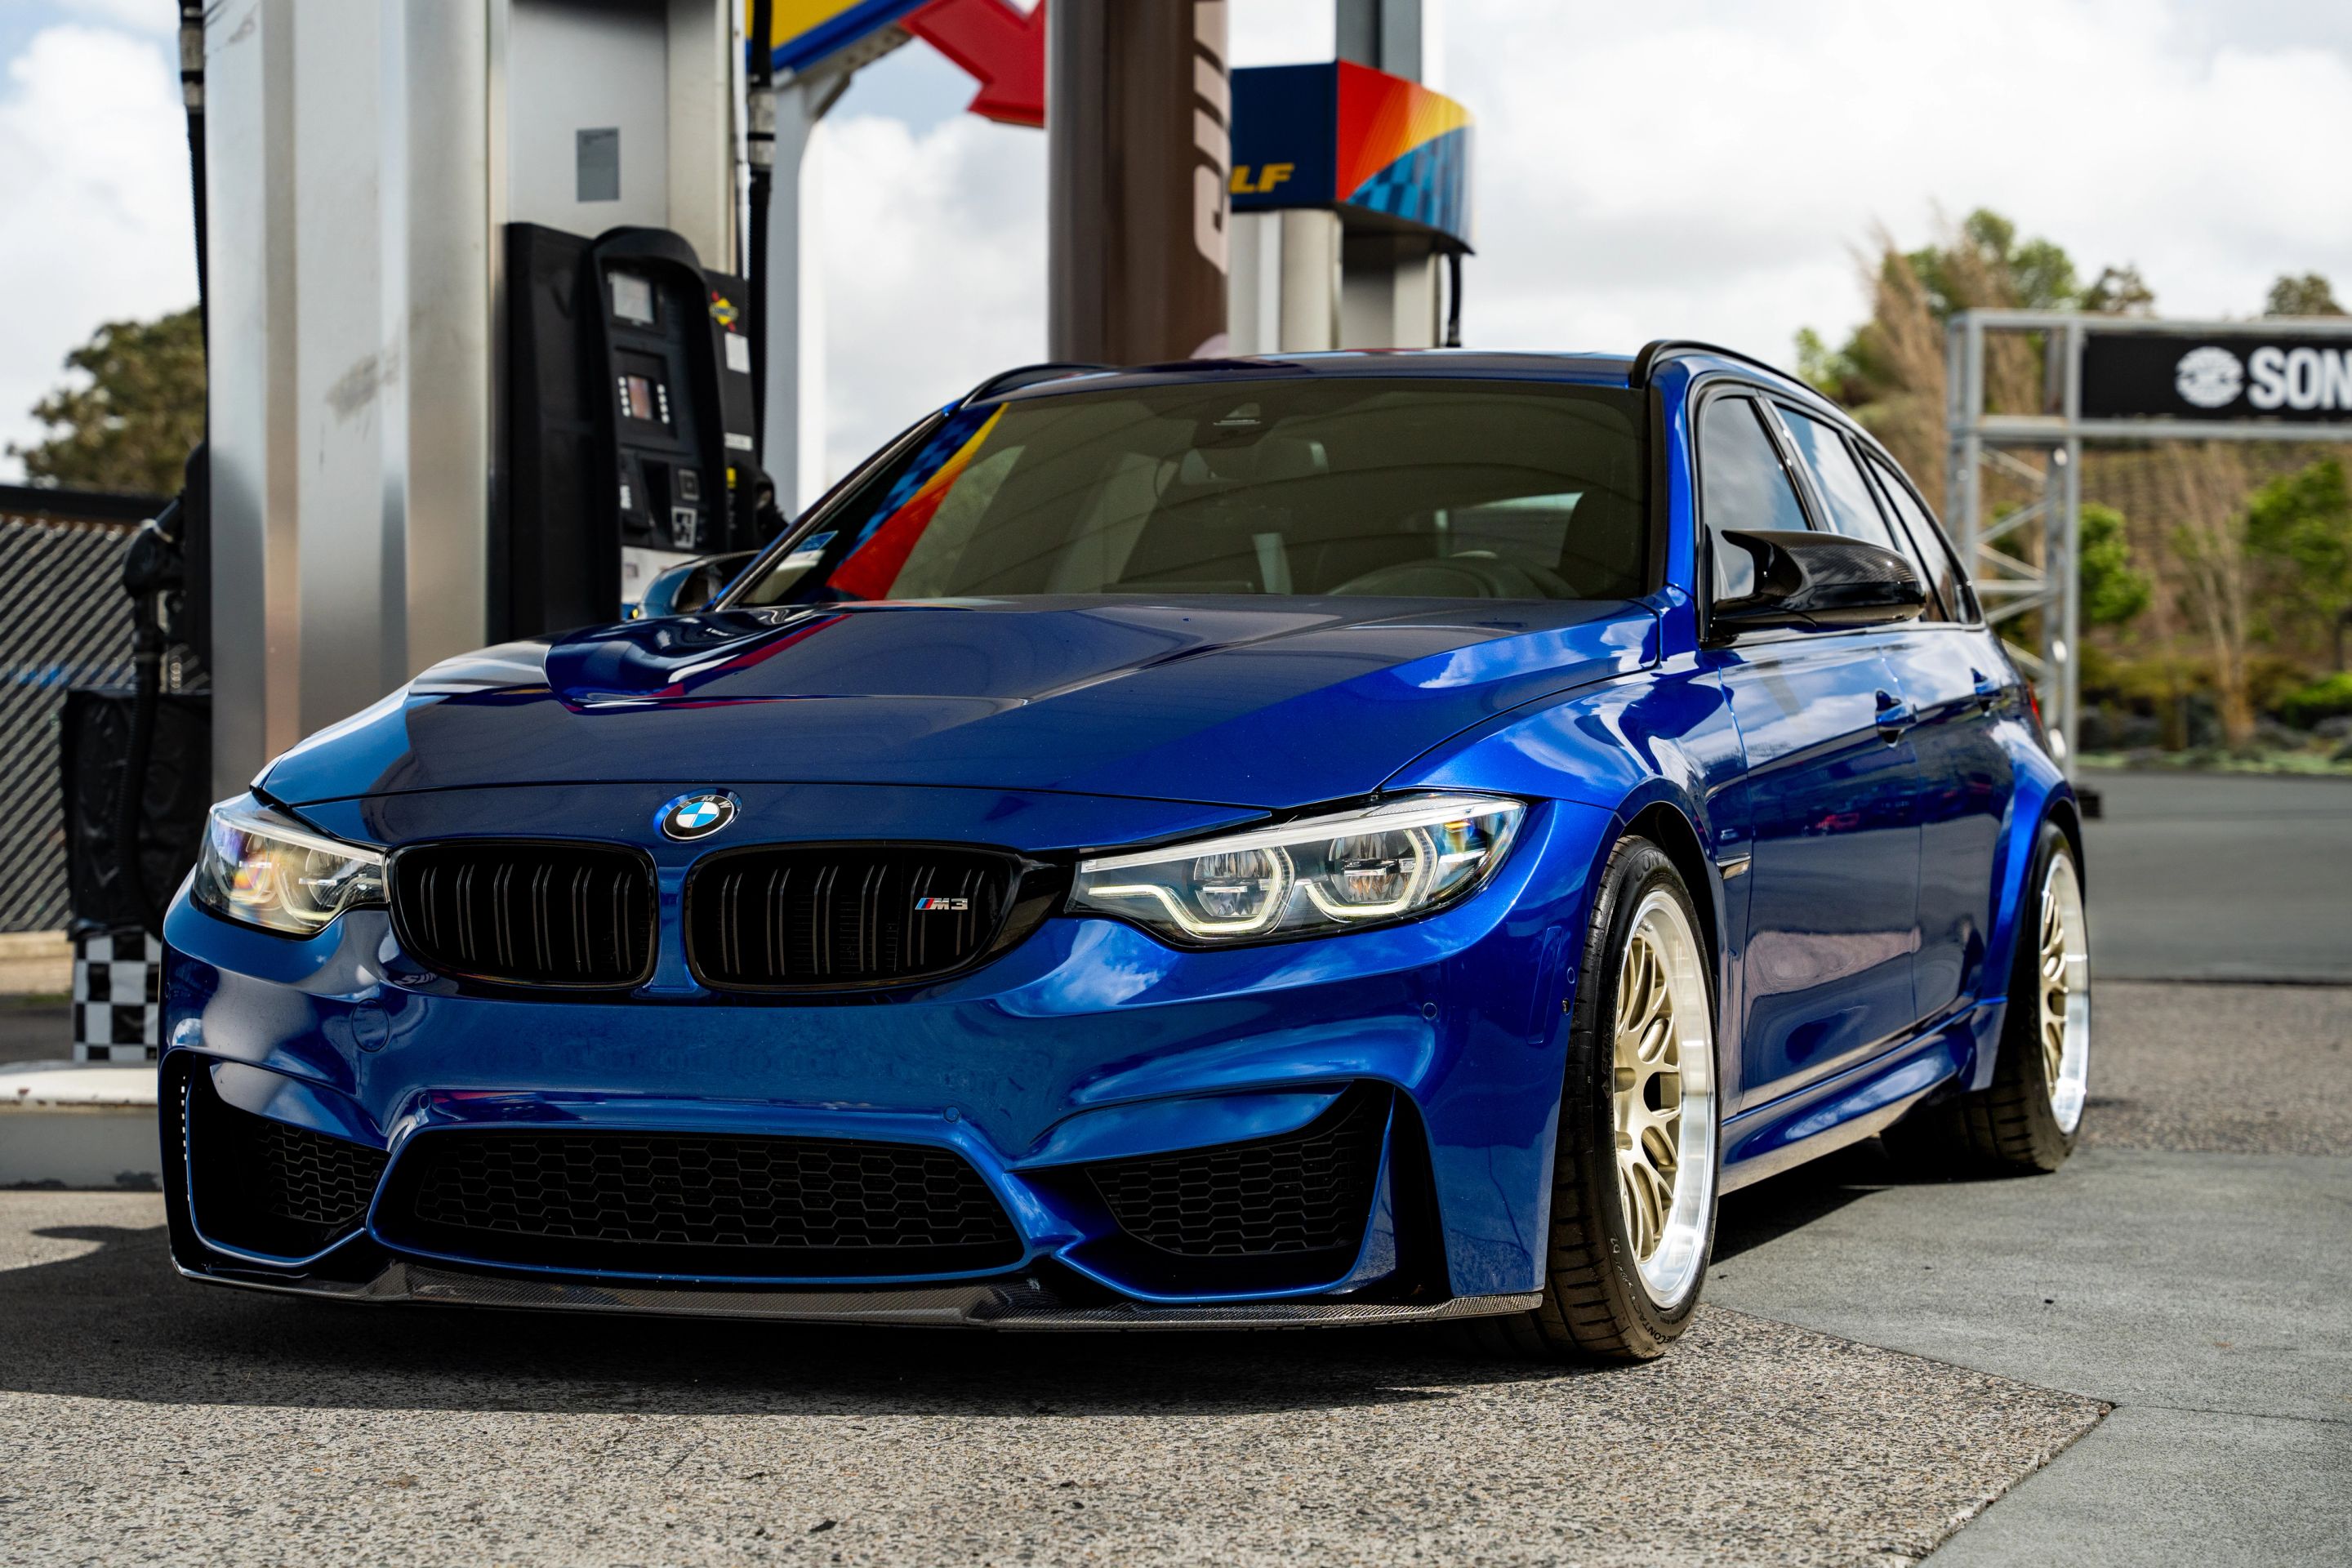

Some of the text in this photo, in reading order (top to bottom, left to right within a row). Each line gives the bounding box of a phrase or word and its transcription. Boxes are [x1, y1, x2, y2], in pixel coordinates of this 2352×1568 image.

[2247, 345, 2352, 411] SON
[679, 795, 732, 808] BMW
[929, 898, 969, 911] M3
